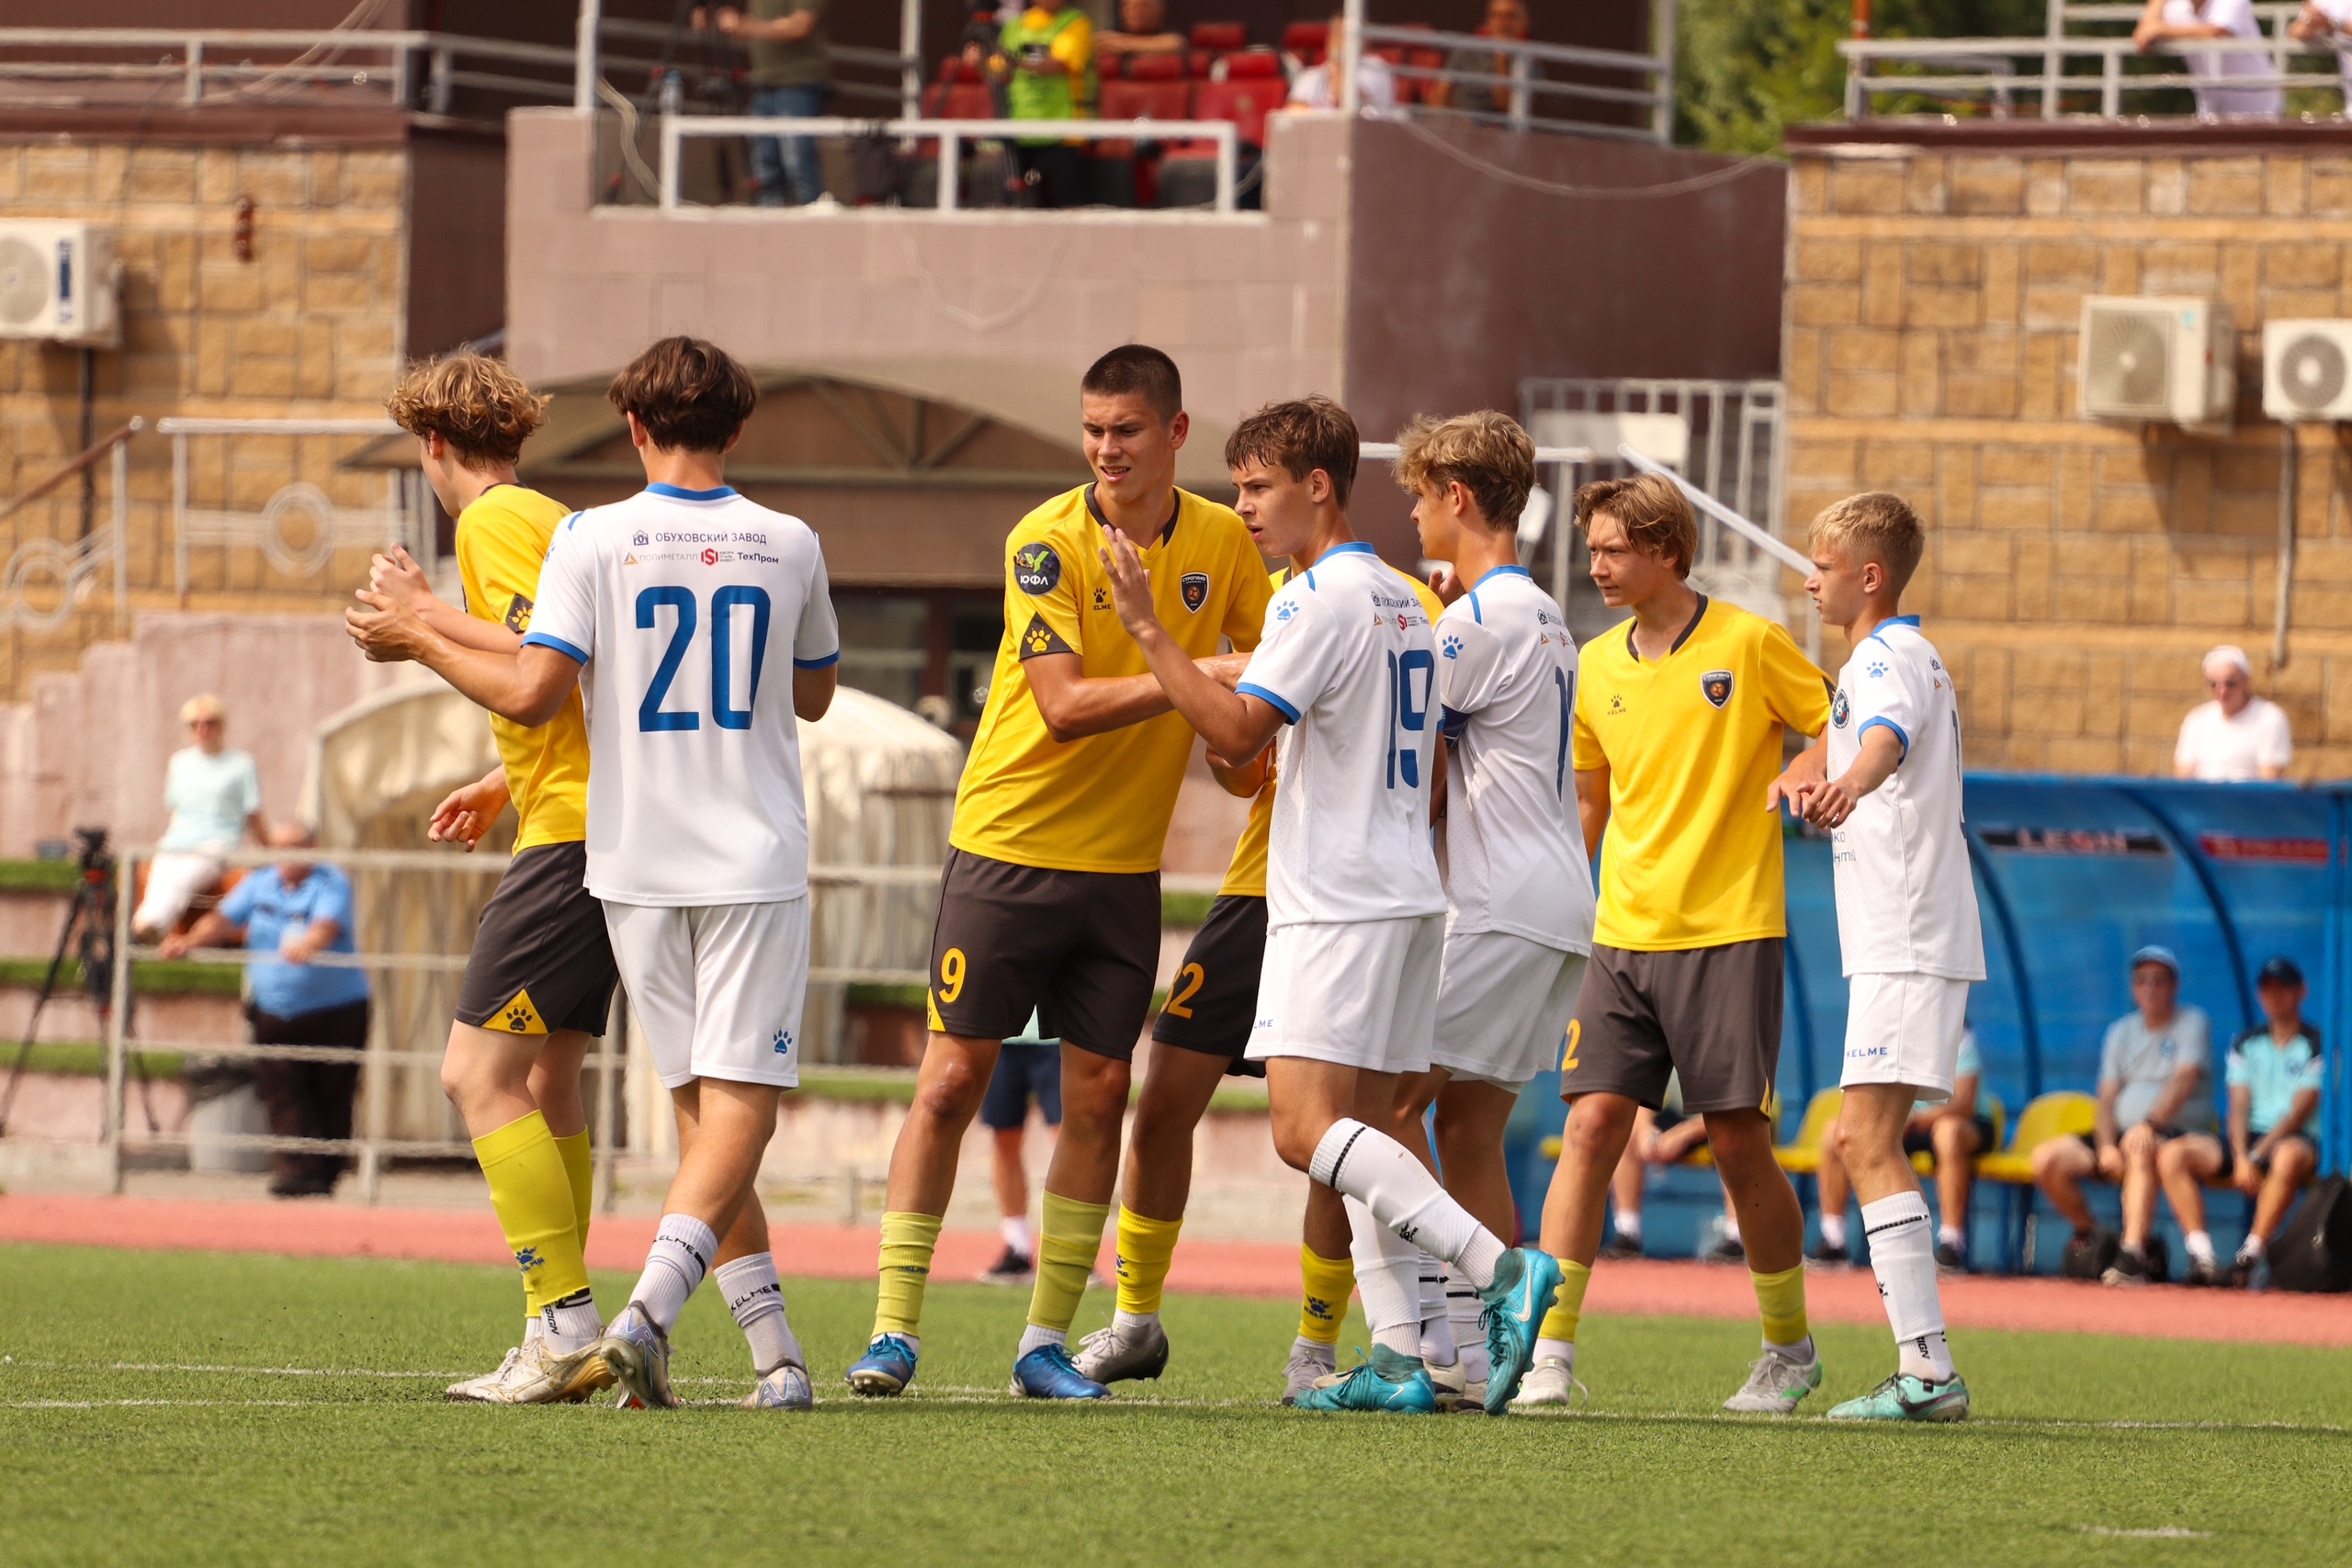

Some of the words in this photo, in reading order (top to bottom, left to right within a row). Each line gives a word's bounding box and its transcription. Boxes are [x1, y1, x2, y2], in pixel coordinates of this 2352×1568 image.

[655, 531, 729, 543] ОБУХОВСКИЙ
[731, 533, 767, 545] ЗАВОД
[639, 554, 698, 562] ПОЛИМЕТАЛЛ
[737, 552, 779, 564] ТехПром
[1020, 575, 1049, 586] ЮФЛ
[635, 585, 771, 732] 20
[1607, 706, 1626, 716] KELME
[1386, 649, 1435, 790] 19
[938, 947, 967, 1003] 9
[1253, 1019, 1274, 1029] LME
[1561, 1018, 1581, 1071] 2
[1846, 1046, 1888, 1058] KELME
[729, 1285, 772, 1316] KELME
[543, 1303, 560, 1336] ESIGN
